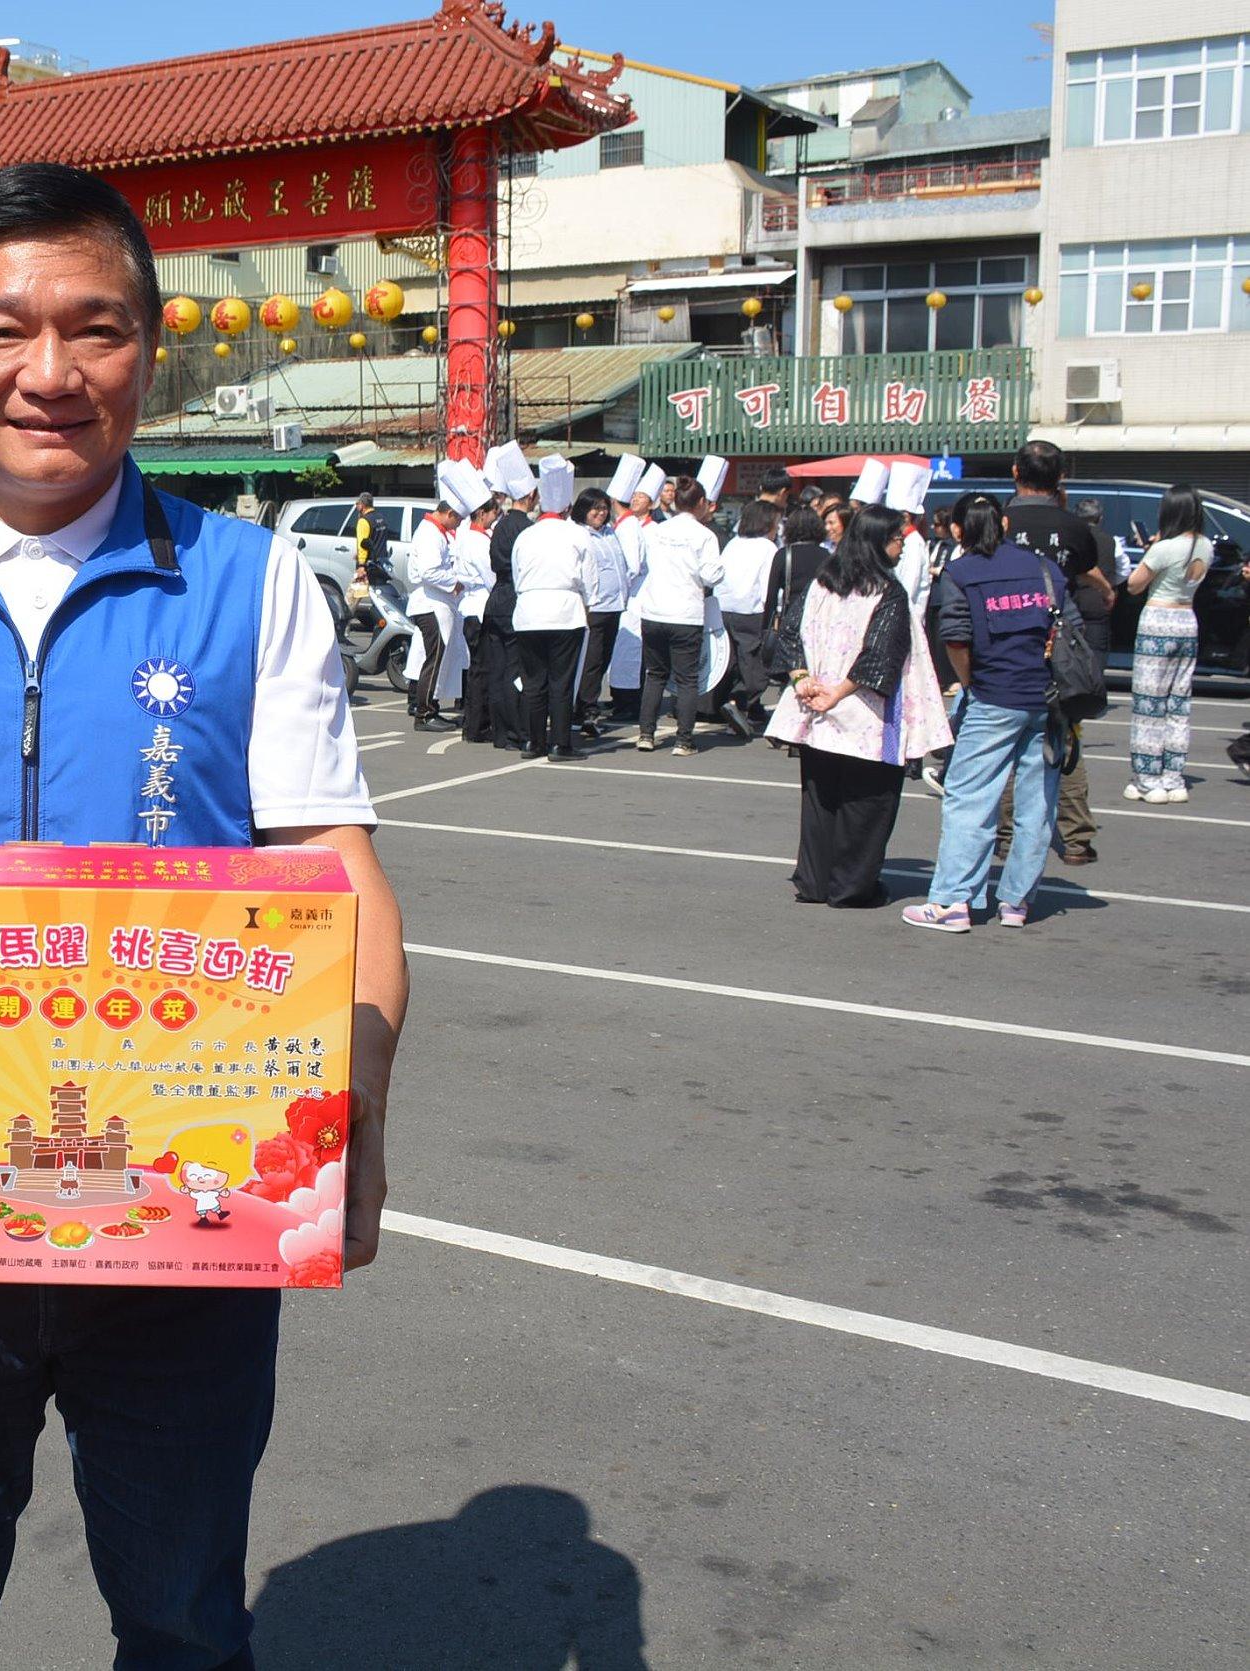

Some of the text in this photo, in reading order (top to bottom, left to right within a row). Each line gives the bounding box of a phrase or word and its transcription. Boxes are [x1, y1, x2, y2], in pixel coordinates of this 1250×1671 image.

[668, 378, 1001, 431] 可可自助餐
[138, 724, 184, 848] 嘉義市
[290, 908, 333, 921] 嘉義市
[111, 928, 293, 994] 桃喜迎新
[152, 1084, 258, 1098] 暨全體董監事
